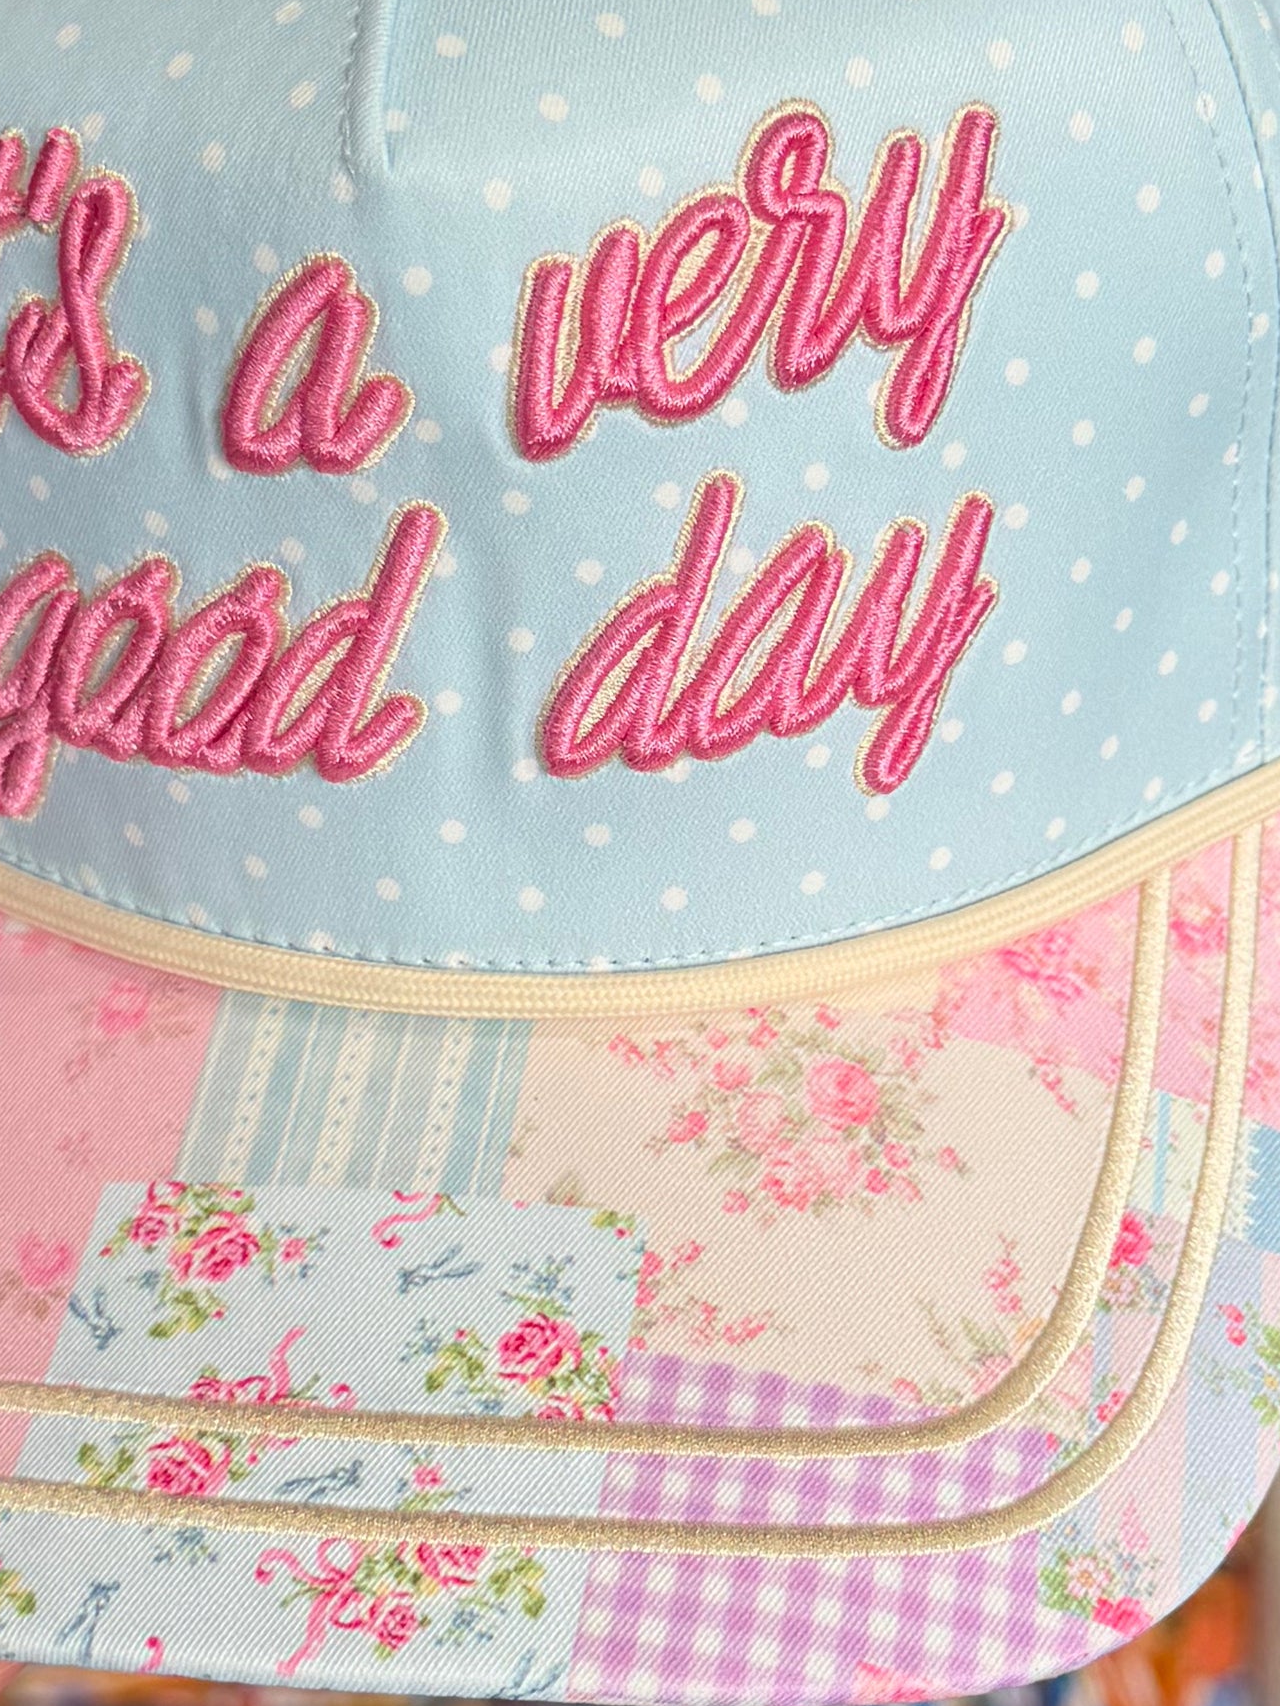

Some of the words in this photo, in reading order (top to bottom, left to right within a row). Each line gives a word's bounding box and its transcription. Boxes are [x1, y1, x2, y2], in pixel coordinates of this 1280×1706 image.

[214, 257, 408, 480] a
[509, 105, 1009, 466] very
[536, 472, 1000, 799] day
